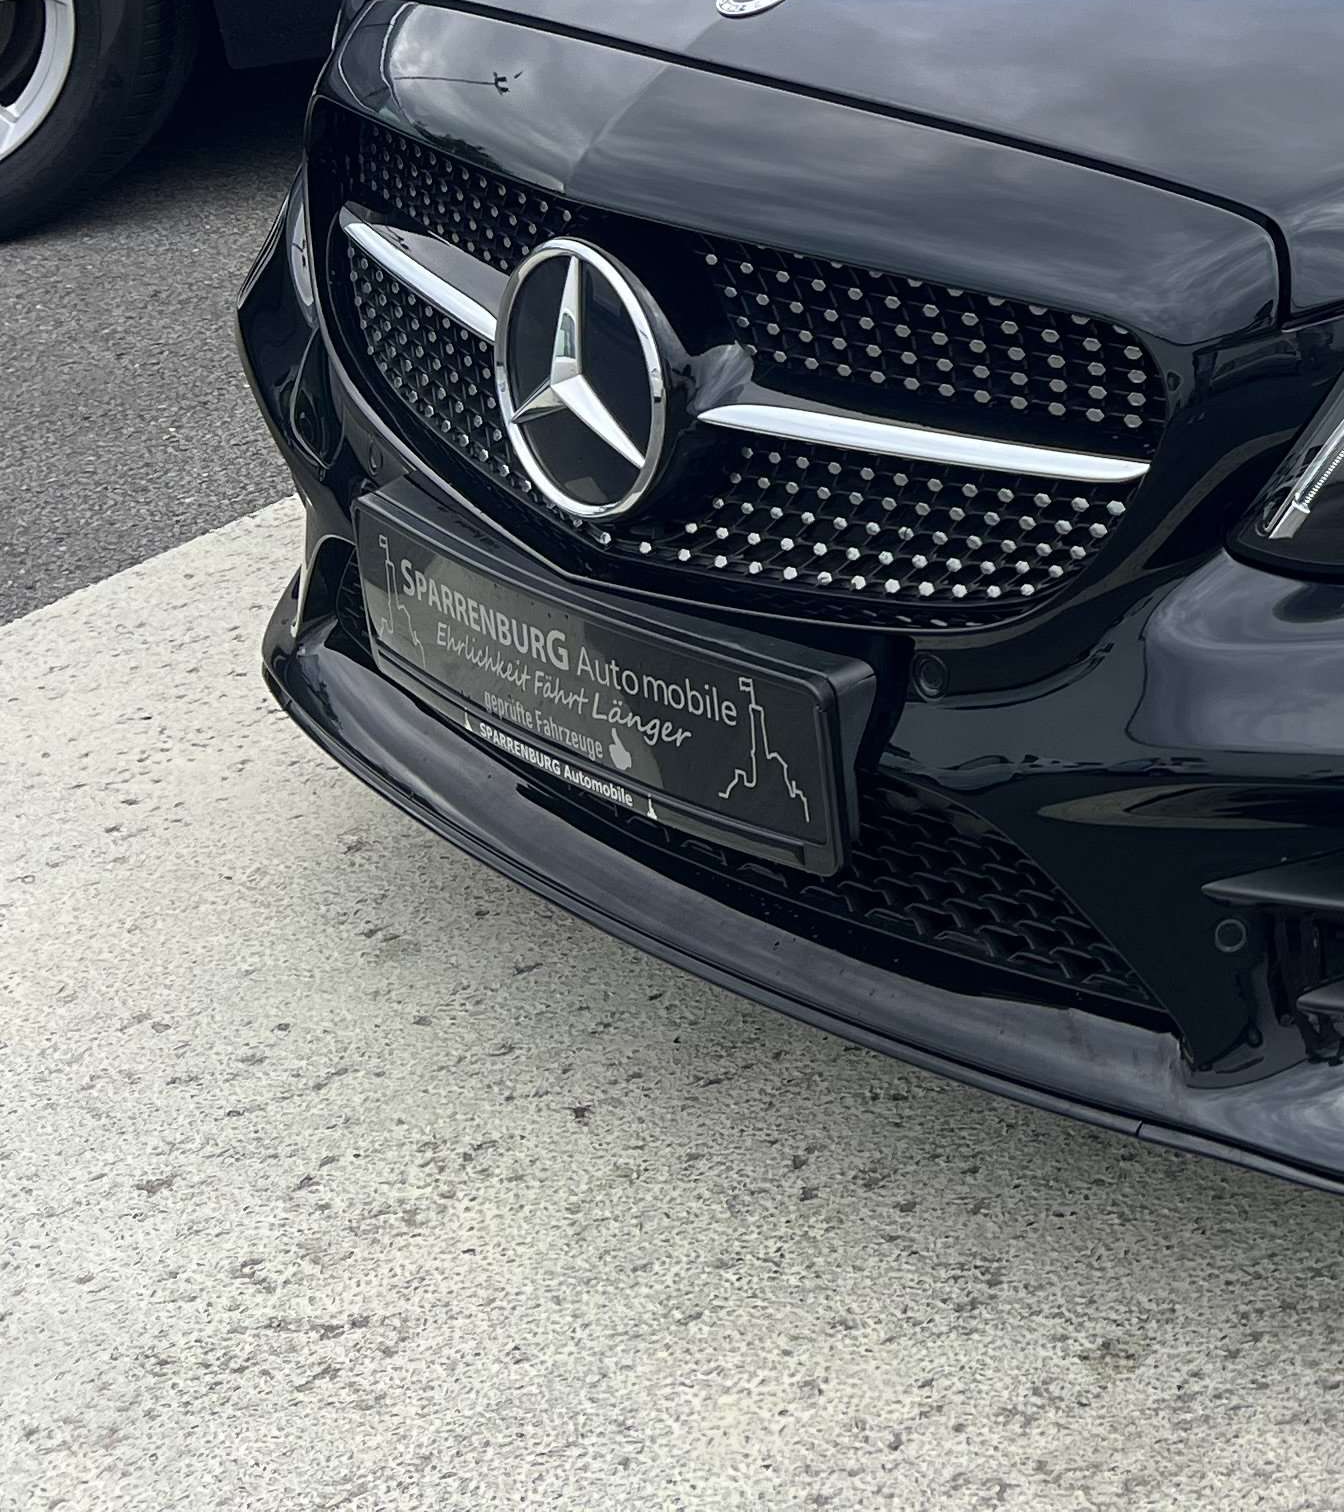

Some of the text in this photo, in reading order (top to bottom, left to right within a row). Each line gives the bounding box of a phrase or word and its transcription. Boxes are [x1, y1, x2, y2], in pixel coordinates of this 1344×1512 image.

[401, 559, 737, 726] SPARRENBURG Automobile
[436, 622, 692, 747] Ehrlichkeit Fährt Länger
[479, 722, 633, 807] SPARRENBURG Automobile
[484, 691, 603, 761] geprüfte Fahrzeuge
